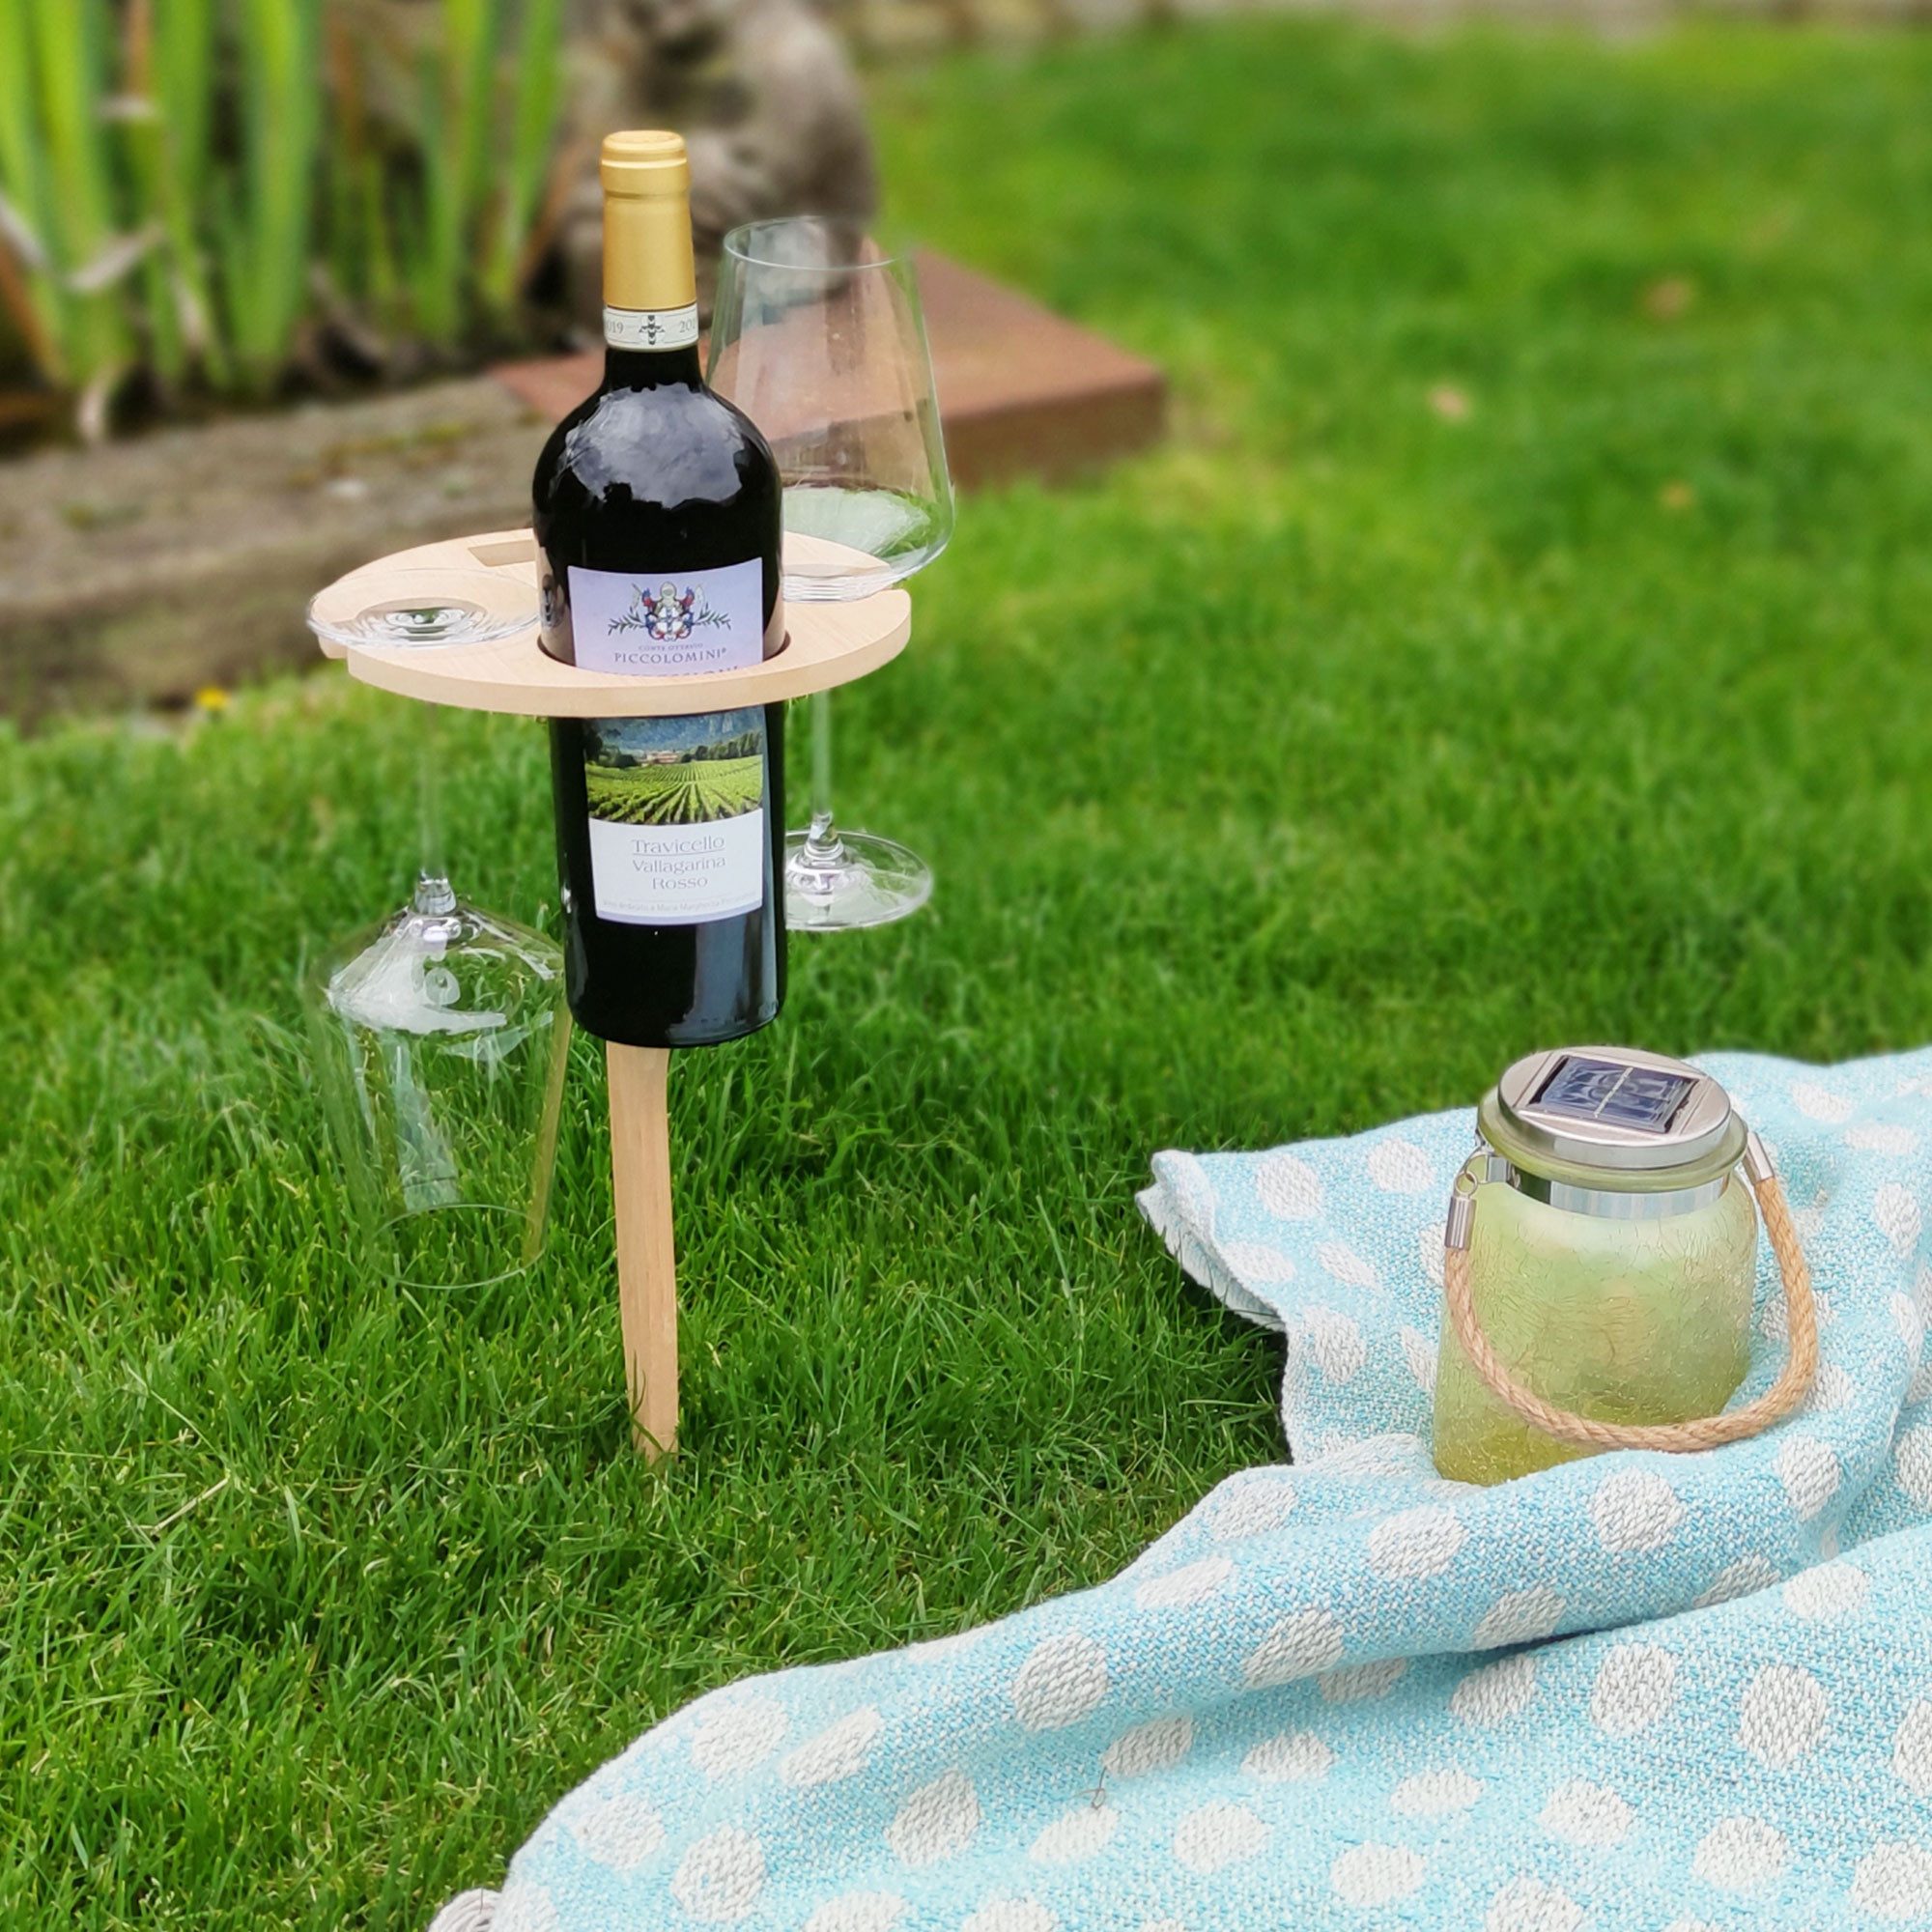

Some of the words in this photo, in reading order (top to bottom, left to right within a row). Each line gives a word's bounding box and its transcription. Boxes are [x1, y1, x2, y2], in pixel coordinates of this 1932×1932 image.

[607, 318, 625, 334] 019
[679, 318, 696, 333] 201
[631, 835, 725, 854] Travicello
[633, 856, 726, 874] Vallagarina
[652, 876, 708, 890] Rosso
